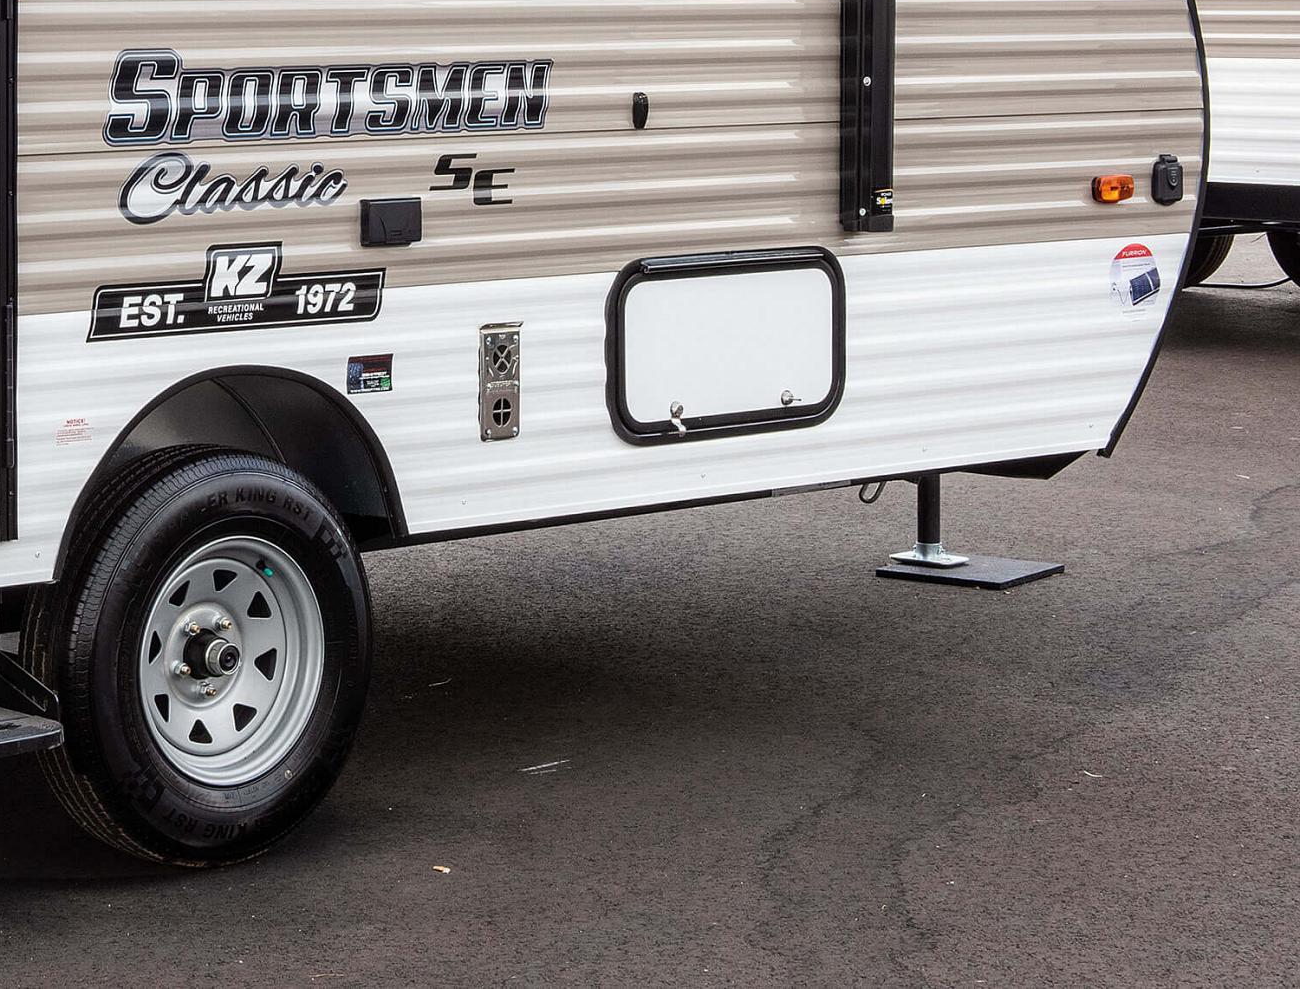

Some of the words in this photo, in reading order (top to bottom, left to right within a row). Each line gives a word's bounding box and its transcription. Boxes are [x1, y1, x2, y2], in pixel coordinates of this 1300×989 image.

[103, 48, 555, 147] SPORTSMEN
[117, 150, 349, 225] Classic
[210, 253, 275, 297] KZ
[118, 293, 185, 329] EST.
[295, 281, 356, 315] 1972
[207, 302, 265, 315] RECREATIONAL
[216, 311, 255, 323] VEHICLES
[234, 486, 277, 504] KING
